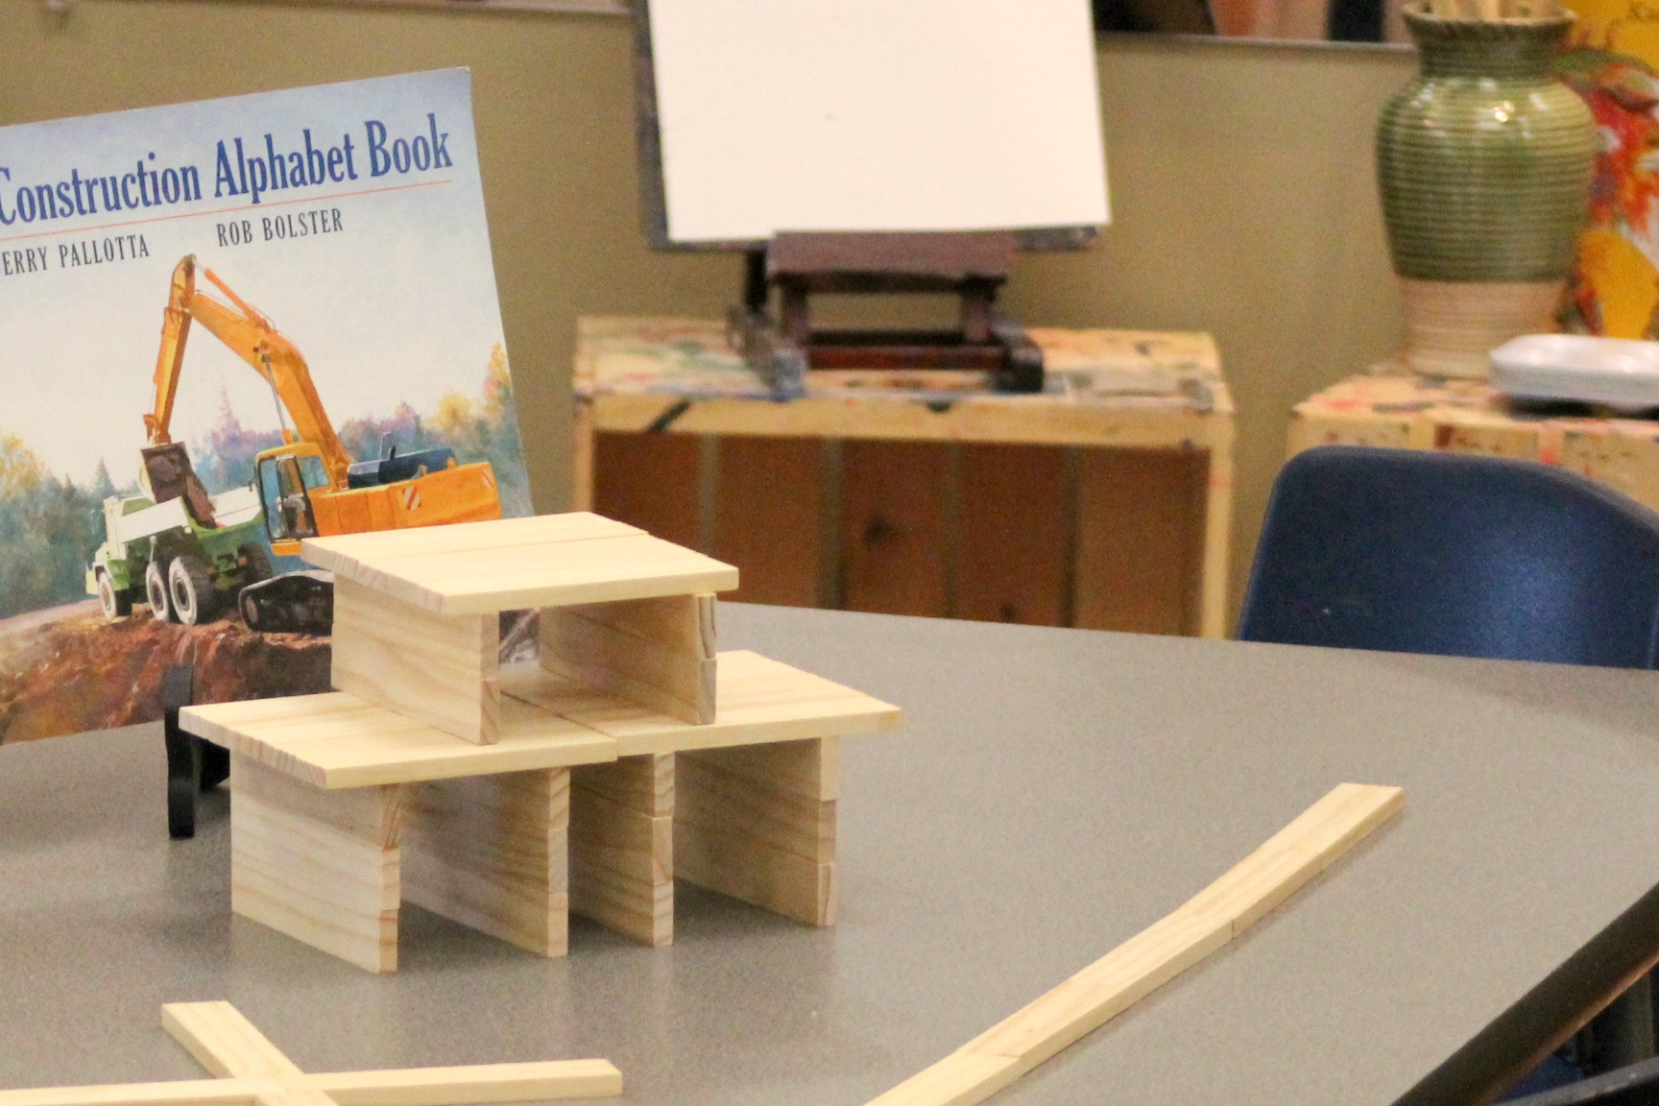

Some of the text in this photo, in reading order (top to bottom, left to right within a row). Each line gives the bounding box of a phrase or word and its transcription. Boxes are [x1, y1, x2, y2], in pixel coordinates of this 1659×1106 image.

[214, 129, 357, 204] Alphabet
[364, 113, 452, 178] Book
[217, 208, 344, 248] ROB BOLSTER
[60, 234, 150, 269] PALLOTTA
